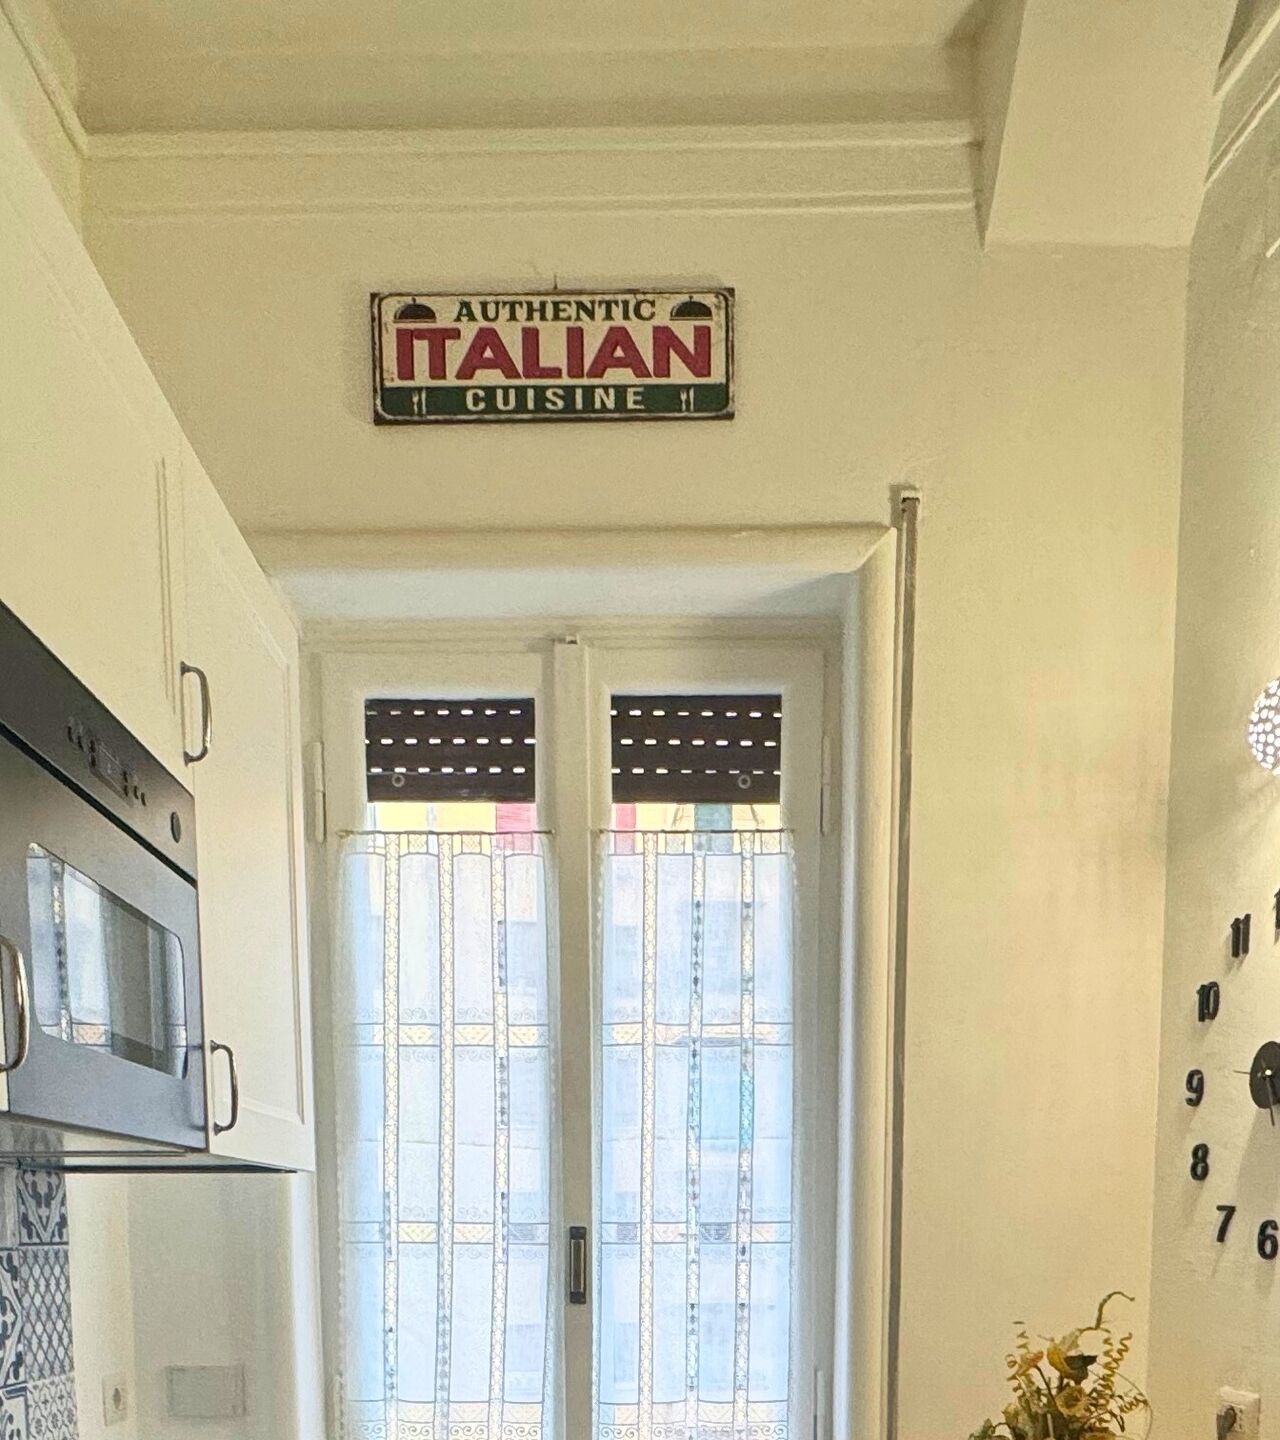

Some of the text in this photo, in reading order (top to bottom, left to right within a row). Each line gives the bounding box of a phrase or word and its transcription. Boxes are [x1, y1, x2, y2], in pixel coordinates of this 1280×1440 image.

[452, 298, 658, 323] AUTHENTIC
[394, 325, 713, 382] ITALIAN
[464, 386, 647, 412] CUISINE
[1230, 913, 1252, 958] 11
[1196, 981, 1220, 1023] 10
[1185, 1068, 1205, 1107] 9
[1190, 1143, 1210, 1181] 8
[1216, 1204, 1237, 1243] 7
[1257, 1219, 1279, 1260] 6
